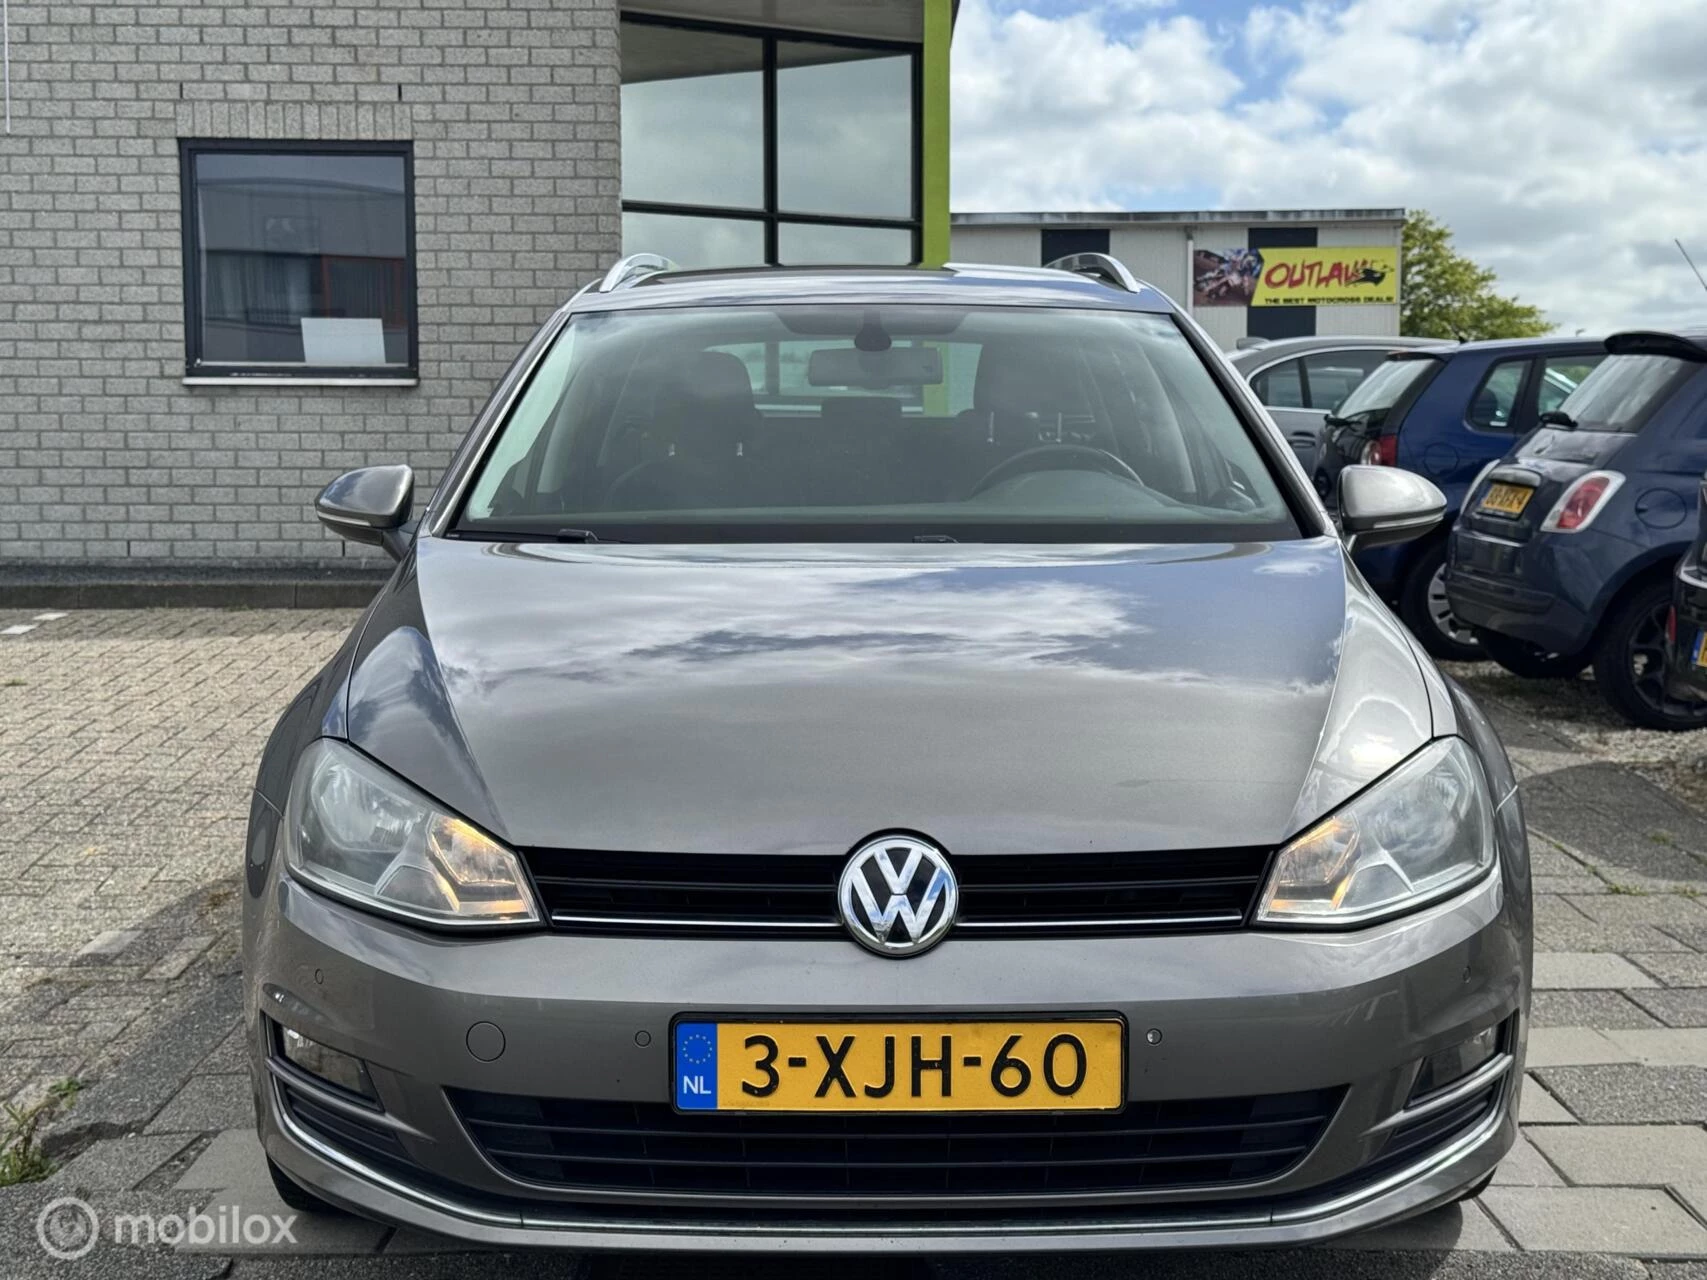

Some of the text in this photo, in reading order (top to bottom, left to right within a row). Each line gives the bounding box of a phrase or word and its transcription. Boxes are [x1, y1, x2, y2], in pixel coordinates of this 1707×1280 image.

[1264, 296, 1280, 305] THE
[1282, 296, 1304, 305] BEST
[1307, 296, 1361, 304] MOTOCROSS
[741, 1033, 1088, 1098] 3-XJH-60
[682, 1075, 712, 1096] NL
